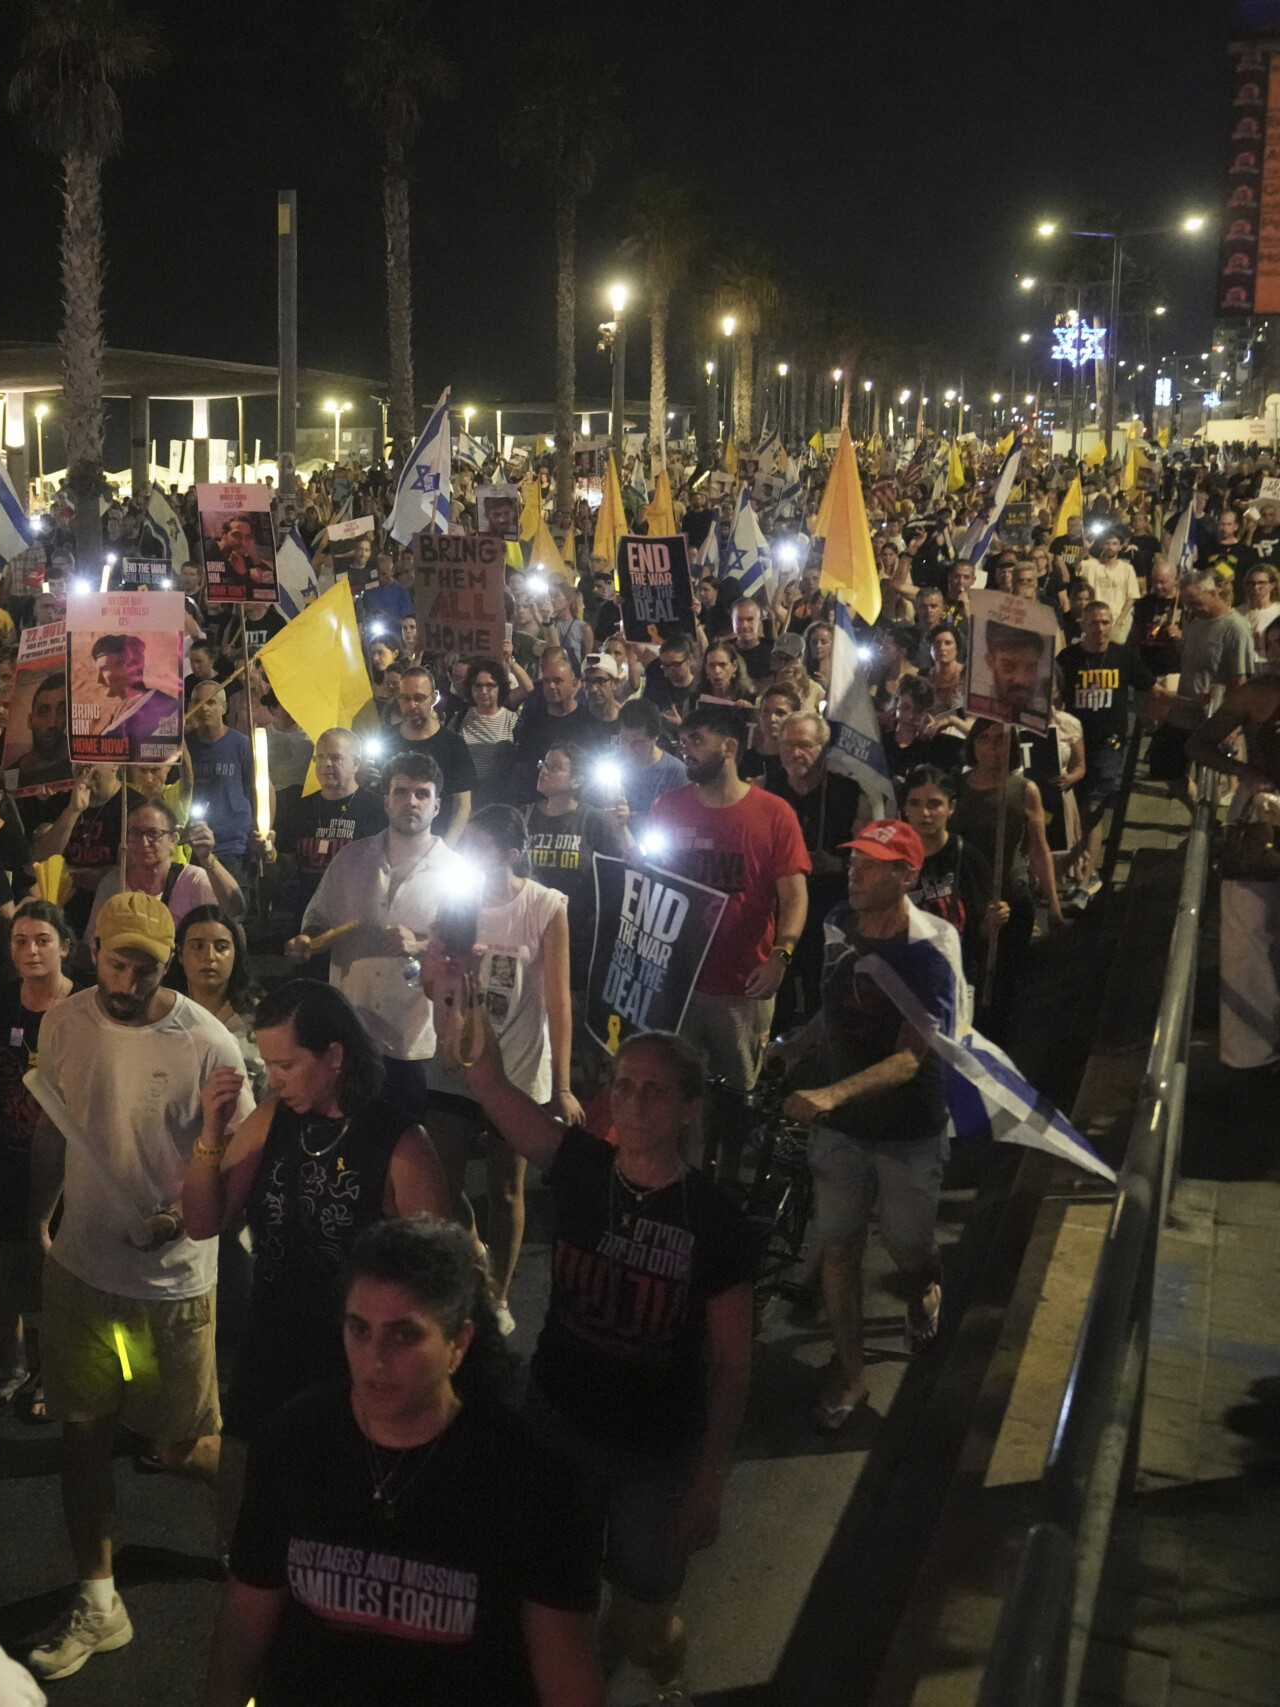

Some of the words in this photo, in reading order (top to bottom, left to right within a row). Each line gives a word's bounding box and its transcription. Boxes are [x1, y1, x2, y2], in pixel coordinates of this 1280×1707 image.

[420, 534, 498, 564] BRING
[627, 543, 671, 573] END
[125, 562, 137, 573] END
[138, 562, 150, 574] THE
[151, 563, 167, 574] WAR
[417, 566, 487, 590] THEM
[629, 571, 647, 586] THE
[648, 572, 673, 586] WAR
[631, 586, 654, 599] SEAL
[655, 585, 676, 599] THE
[428, 590, 496, 621] ALL
[634, 598, 679, 622] DEAL
[424, 622, 490, 652] HOME
[72, 704, 100, 719] BRING
[1075, 688, 1113, 711] נקום
[72, 720, 90, 735] HIM
[73, 738, 99, 753] HOME
[101, 736, 129, 753] NOW!
[329, 818, 356, 830] מחזירים
[336, 828, 354, 839] אותם
[528, 834, 553, 849] בבי
[555, 834, 581, 850] אתם
[560, 851, 581, 869] הם
[621, 869, 690, 944] END
[617, 916, 638, 949] THE
[636, 932, 673, 969] WAR
[612, 939, 637, 977] SEAL
[638, 957, 668, 993] THE
[601, 960, 655, 1033] DEAL
[634, 1217, 696, 1253] מחזירים
[288, 1537, 364, 1576] HOSTAGES
[363, 1551, 401, 1582] AND
[401, 1558, 478, 1600] MISSING
[287, 1564, 383, 1618] FAMILIES
[387, 1583, 477, 1634] FORUM
